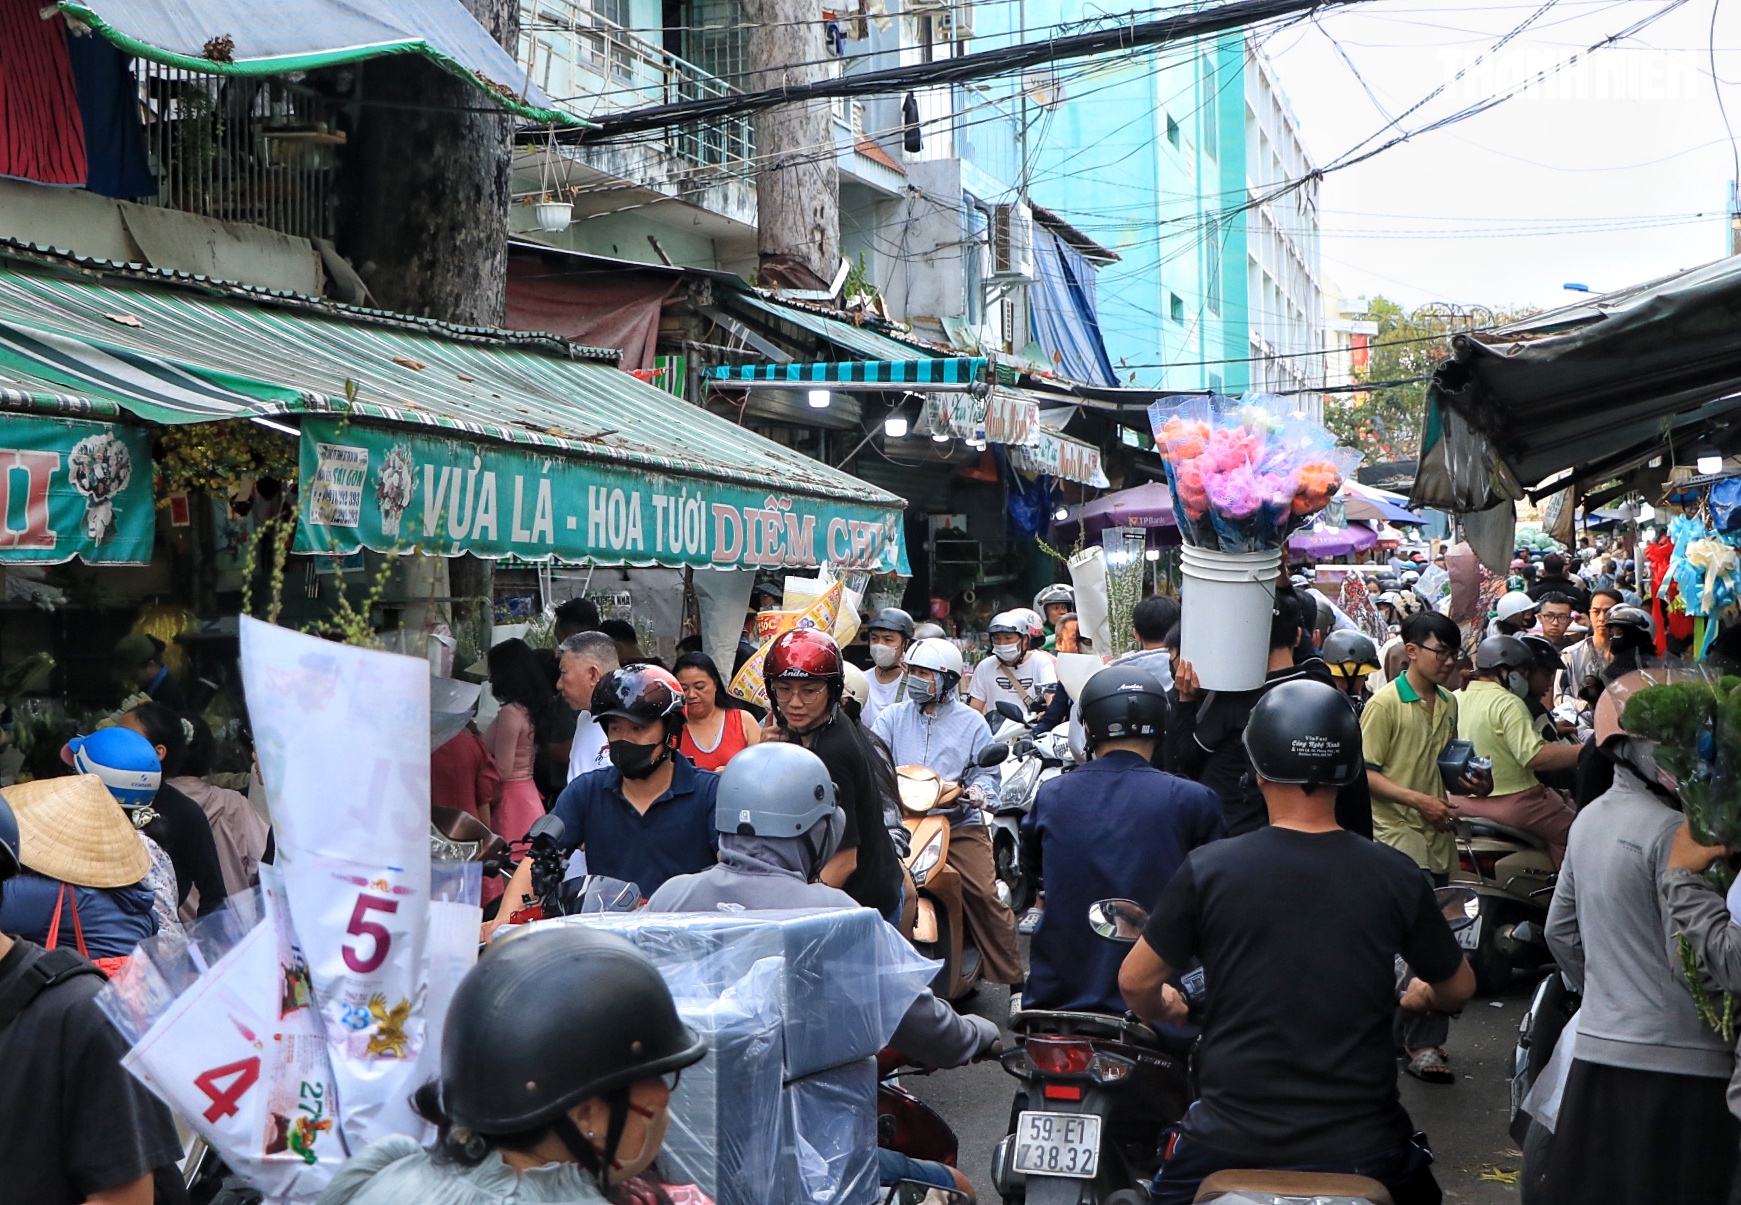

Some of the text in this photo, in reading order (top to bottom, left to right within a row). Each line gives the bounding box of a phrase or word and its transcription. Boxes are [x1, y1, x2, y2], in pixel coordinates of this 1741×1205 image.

[423, 455, 498, 554] VỰA
[511, 460, 554, 544] LÁ
[588, 485, 644, 551] HOA
[652, 486, 706, 555] TƯƠI
[712, 494, 816, 565] DIỄM
[1139, 516, 1165, 524] TPBank
[342, 893, 399, 974] 5
[340, 1003, 371, 1031] 23
[194, 1056, 261, 1124] 4
[298, 1080, 324, 1119] 27
[1020, 1144, 1093, 1174] 738.32
